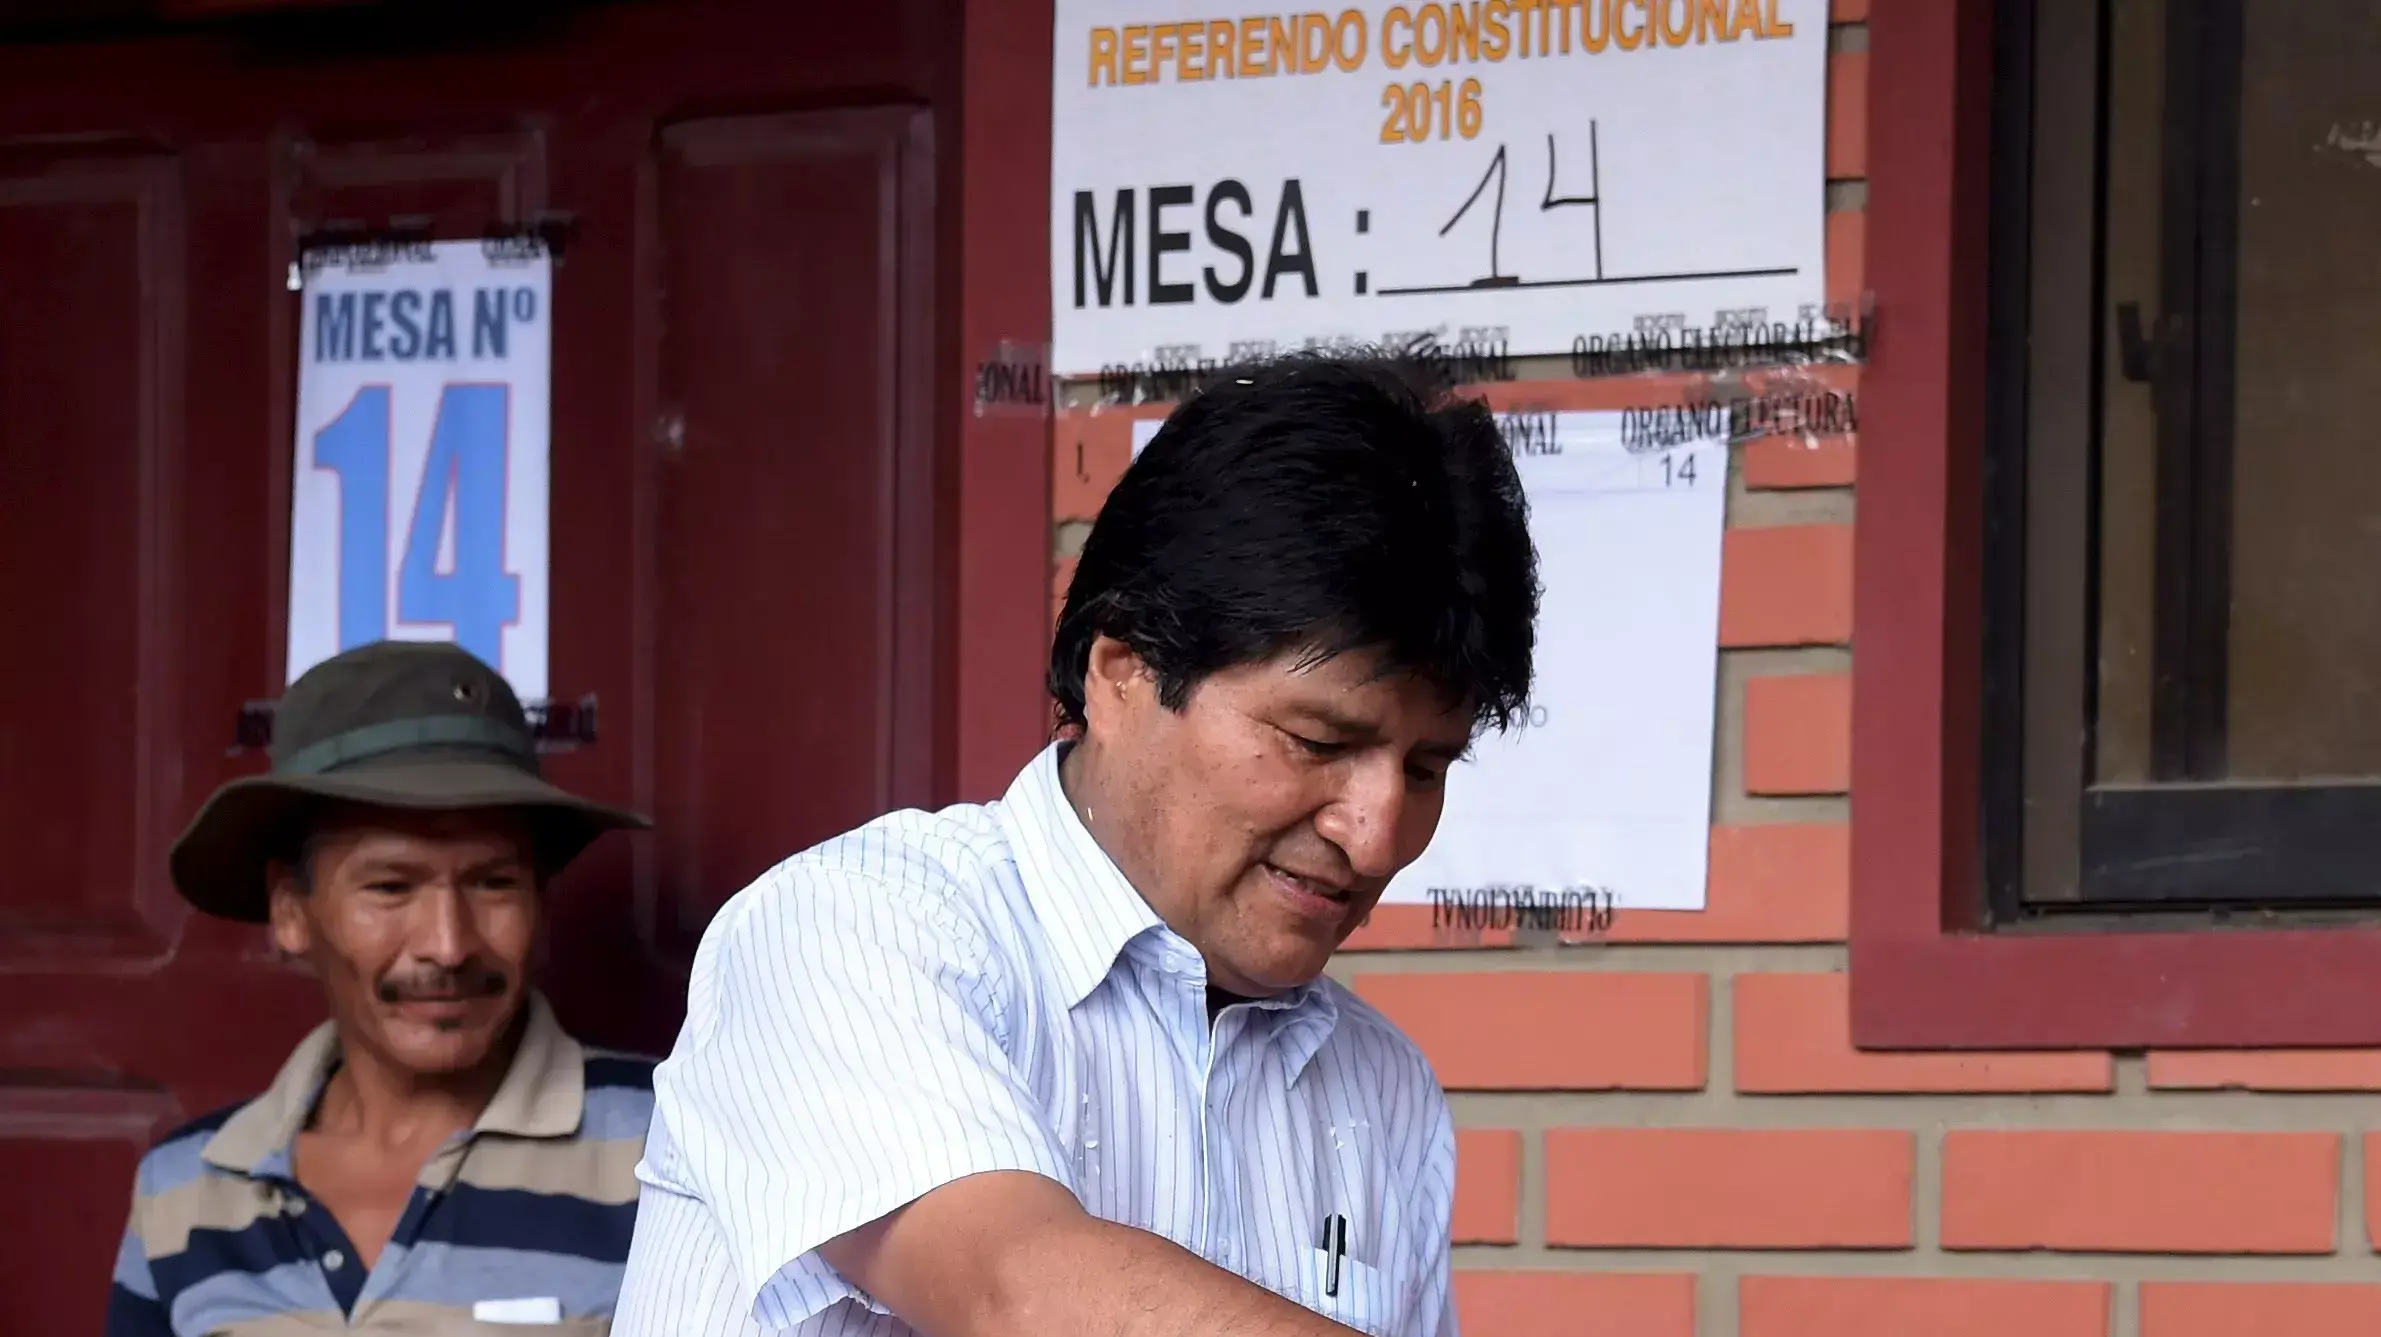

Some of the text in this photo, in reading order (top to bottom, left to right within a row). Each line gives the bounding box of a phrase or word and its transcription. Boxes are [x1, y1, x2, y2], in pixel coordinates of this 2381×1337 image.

[1087, 0, 1794, 88] REFERENDO CONSTITUCIONAL
[1379, 77, 1484, 145] 2016
[1072, 178, 1320, 309] MESA
[1438, 119, 1603, 288] 14
[314, 288, 457, 363] MESA
[1660, 453, 1698, 487] 14
[312, 381, 521, 677] 14
